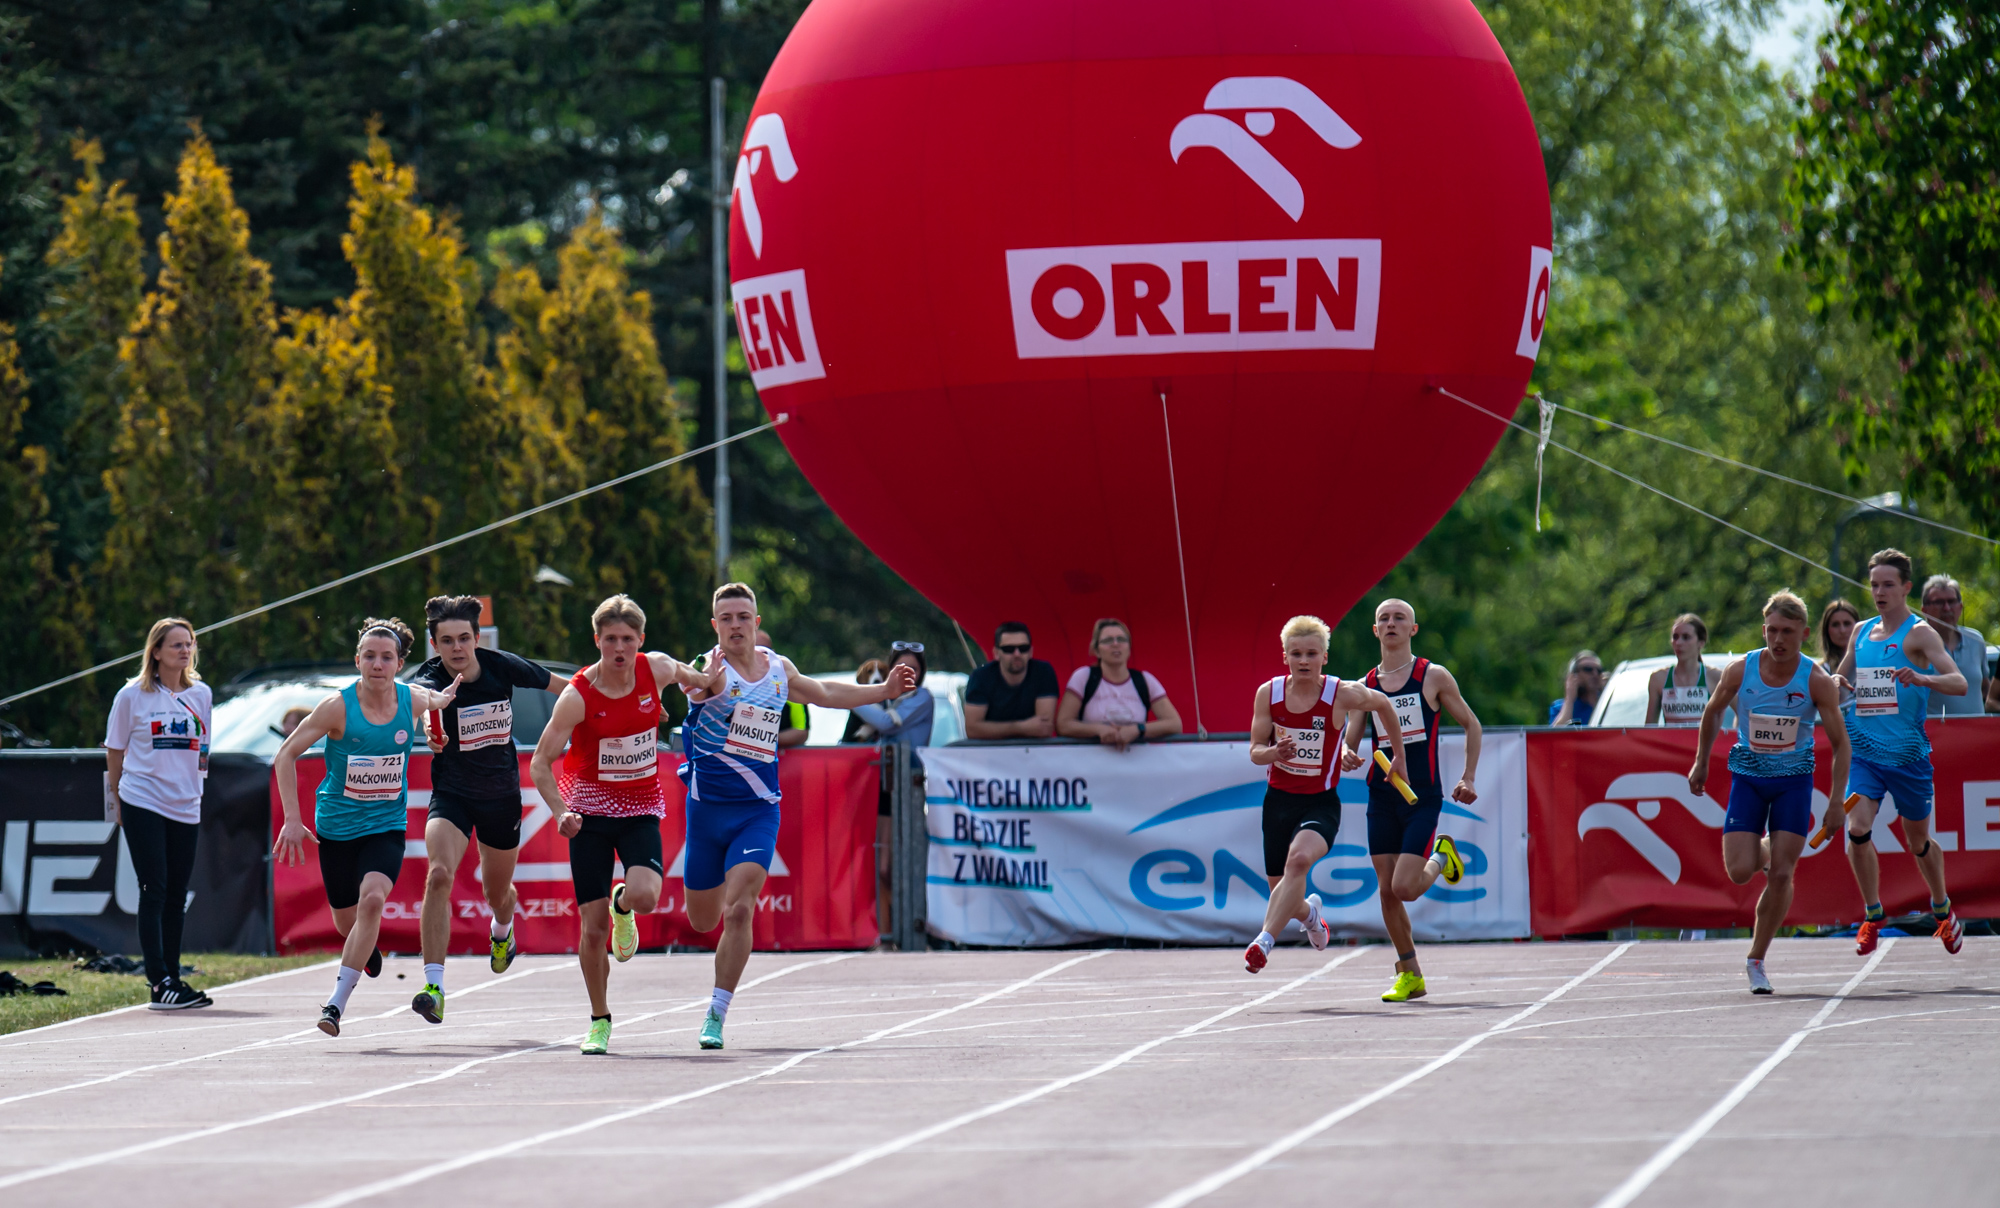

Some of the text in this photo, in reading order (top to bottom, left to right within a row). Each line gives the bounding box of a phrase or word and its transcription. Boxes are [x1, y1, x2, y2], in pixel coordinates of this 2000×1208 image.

[1031, 257, 1359, 342] ORLEN
[1873, 669, 1892, 680] 196
[490, 701, 510, 714] 713
[1395, 696, 1416, 708] 382
[761, 711, 781, 725] 527
[1775, 717, 1797, 727] 179
[634, 731, 652, 747] 511
[729, 722, 778, 744] IWASIUTA
[1298, 731, 1320, 742] 369
[1754, 730, 1785, 741] BRYL
[381, 756, 402, 767] 721
[601, 746, 655, 765] BRYLOWSKI
[947, 777, 1088, 809] NIECH MOC
[953, 813, 1033, 851] BĘDZIE
[953, 854, 1049, 890] Z WAMI!
